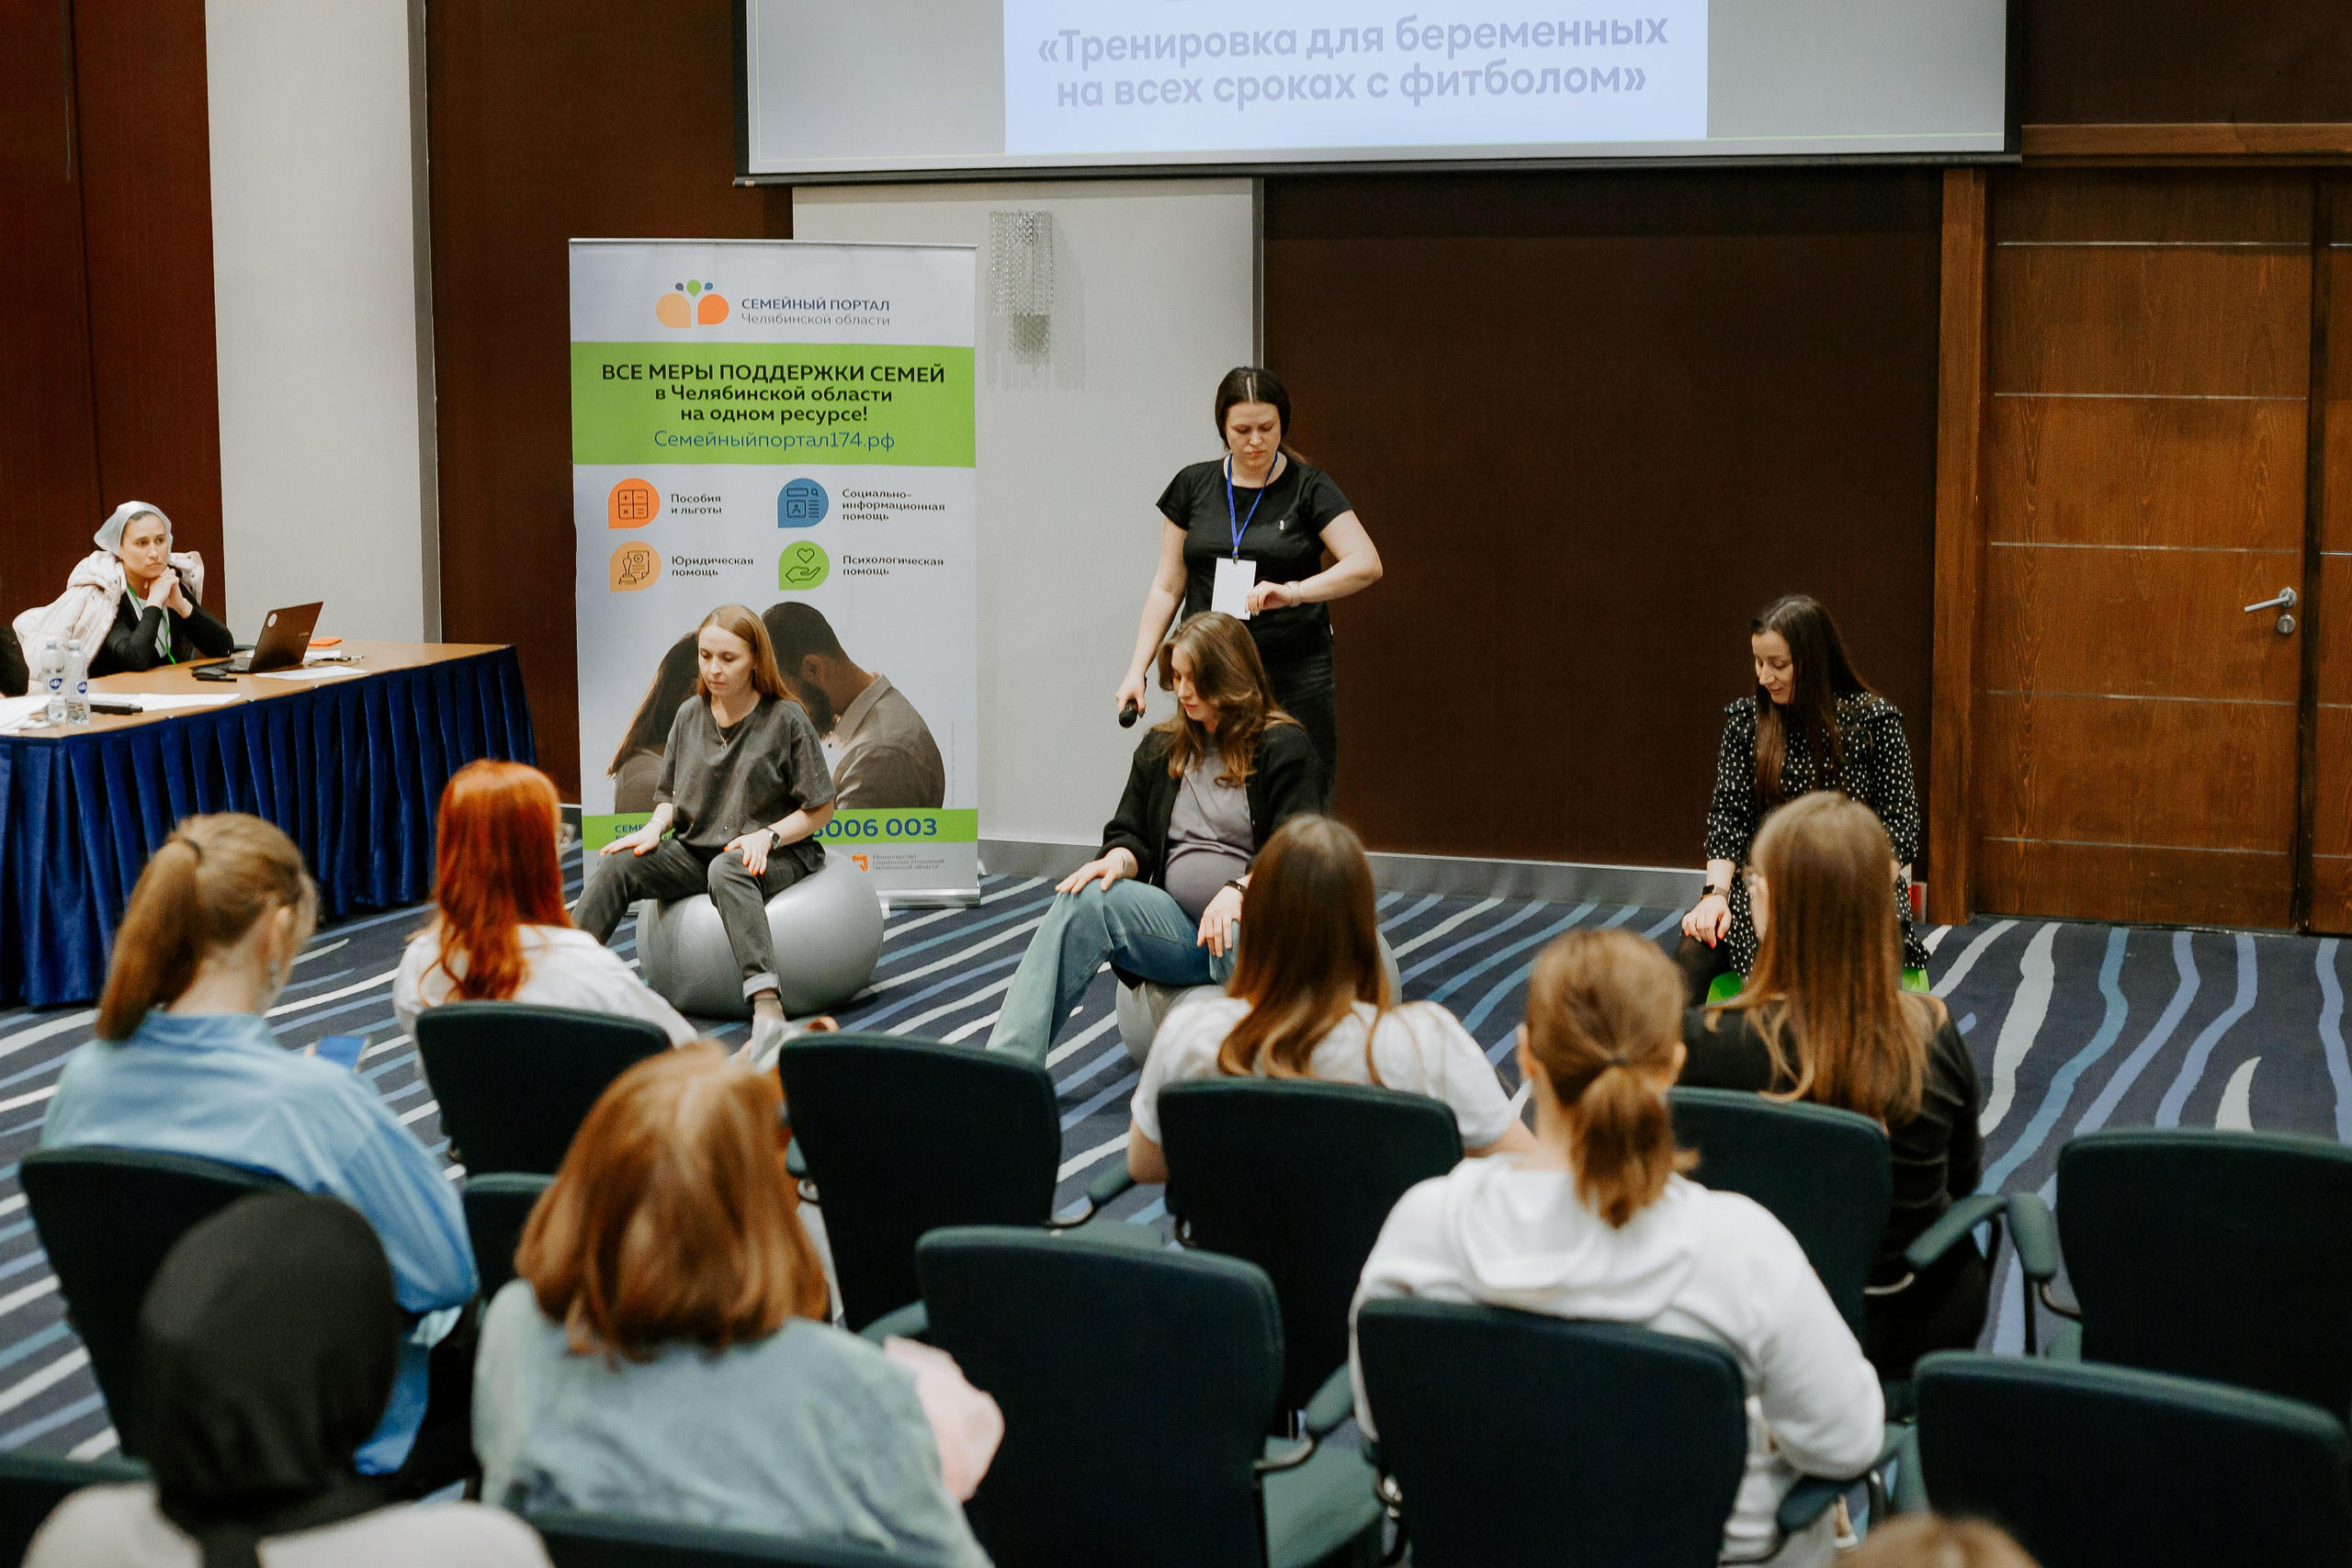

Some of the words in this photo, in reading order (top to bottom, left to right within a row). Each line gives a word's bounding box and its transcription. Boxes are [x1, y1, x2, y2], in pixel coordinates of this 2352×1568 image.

[1036, 28, 1297, 72] «Тренировка
[1306, 26, 1385, 60] для
[1395, 13, 1669, 59] беременных
[1057, 79, 1103, 107] на
[1114, 76, 1204, 106] всех
[1213, 71, 1357, 111] сроках
[1365, 72, 1390, 97] с
[1399, 58, 1647, 107] фитболом»
[741, 296, 826, 310] СЕМЕЙНЫЙ
[830, 299, 890, 311] ПОРТАЛ
[741, 312, 831, 326] Челябинской
[835, 313, 890, 326] области
[602, 364, 643, 380] ВСЕ
[649, 365, 714, 380] МЕРЫ
[720, 364, 865, 383] ПОДДЕРЖКИ
[870, 363, 945, 383] СЕМЕЙ
[655, 389, 666, 400] в
[671, 384, 805, 401] Челябинской
[810, 387, 893, 402] области
[681, 410, 704, 421] на
[709, 410, 775, 424] одном
[780, 407, 868, 425] ресурсе!
[654, 430, 896, 451] Семейныйпортал174.рф
[671, 492, 722, 503] Пособия
[842, 488, 912, 499] Социально-
[842, 500, 945, 512] информационная
[842, 513, 889, 522] помощь
[672, 555, 754, 568] Юридическая
[842, 555, 944, 567] Психологическая
[672, 570, 718, 578] помощь
[842, 568, 889, 576] помощь
[886, 818, 937, 837] 003
